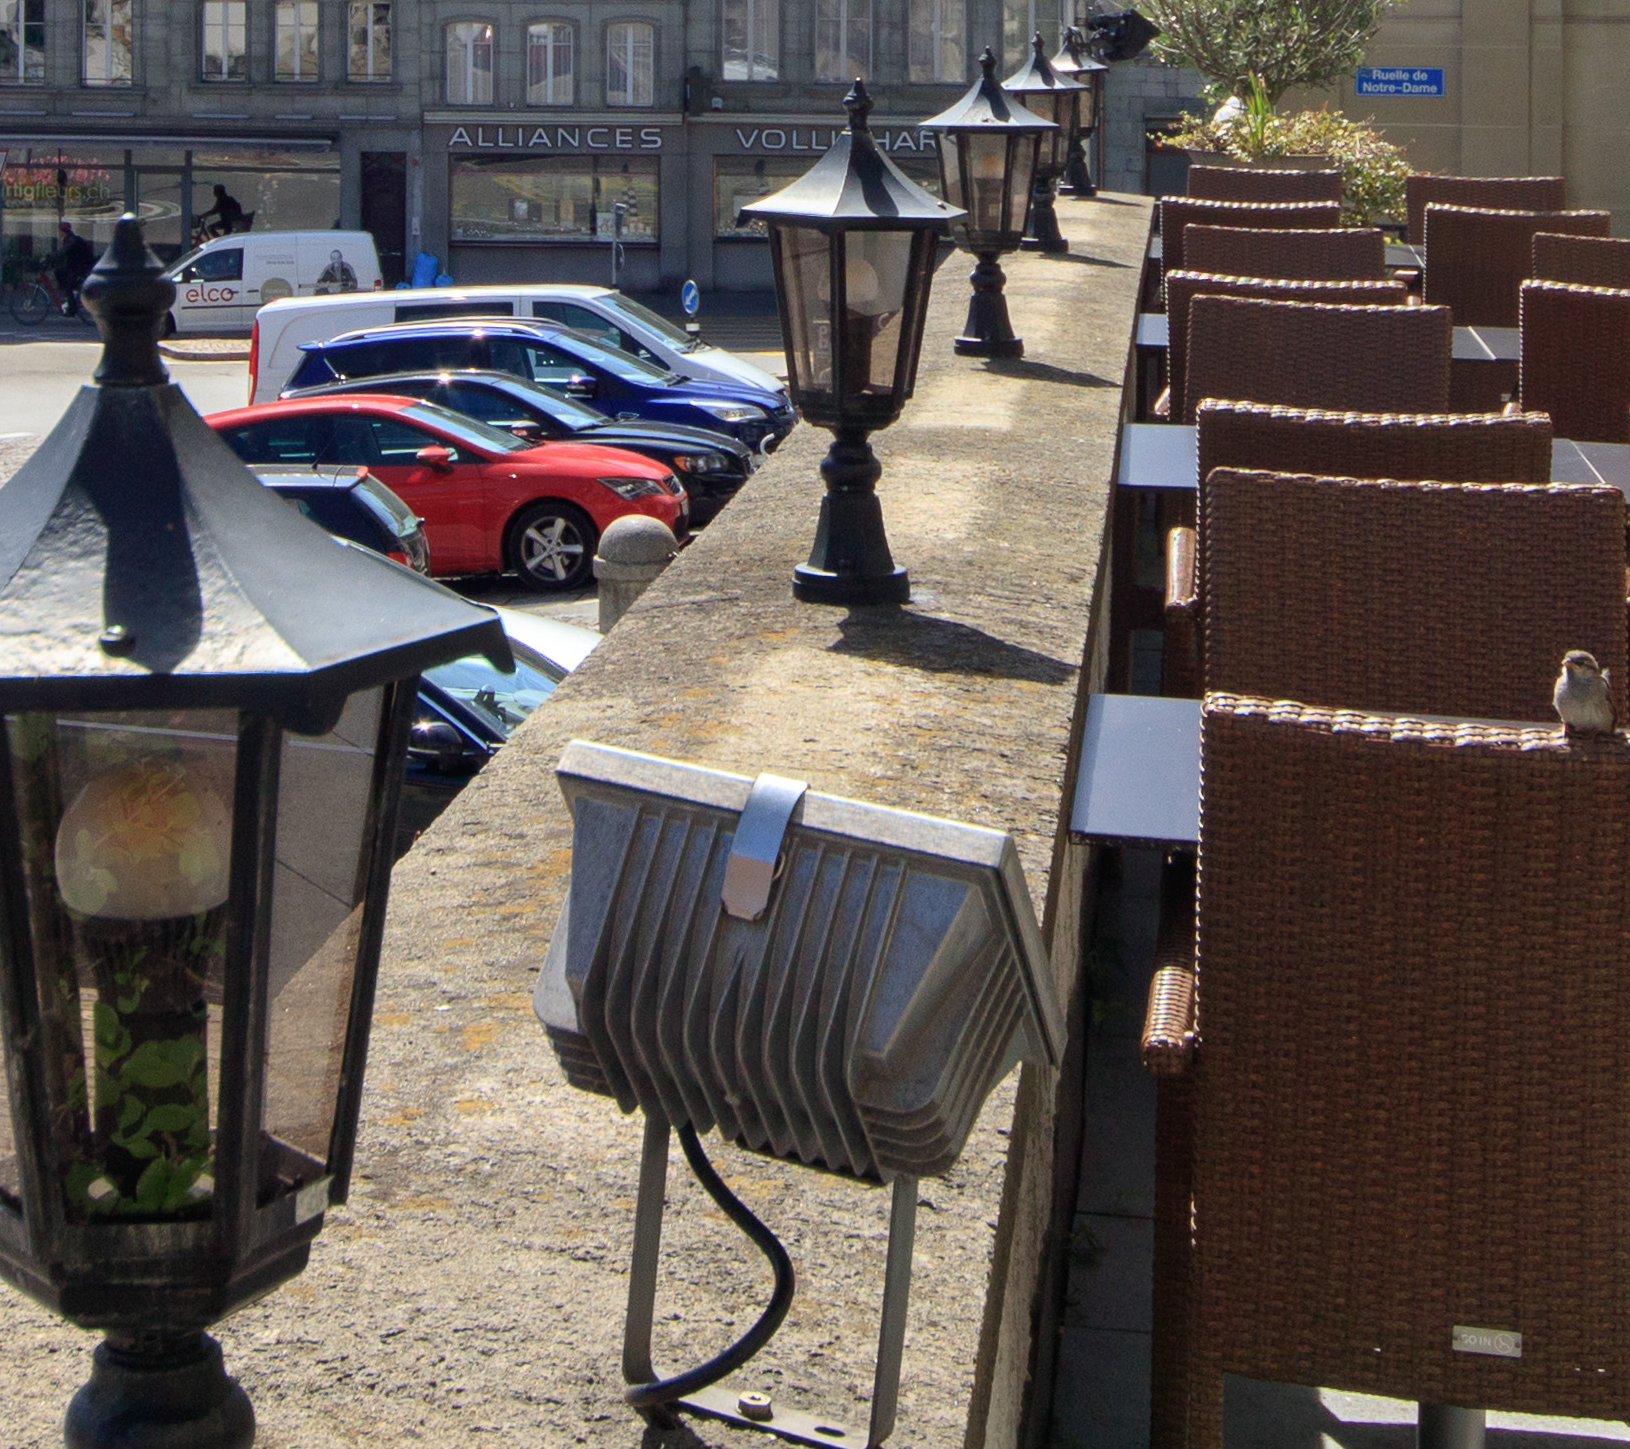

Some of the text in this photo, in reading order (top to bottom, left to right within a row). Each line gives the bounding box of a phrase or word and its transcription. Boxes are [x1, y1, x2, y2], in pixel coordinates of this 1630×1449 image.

[1372, 69, 1428, 81] Ruelle de
[1362, 82, 1438, 93] Notre-Dame
[448, 127, 662, 148] ALLIANCES
[736, 128, 937, 151] VOLLIHAR
[185, 283, 235, 303] elco
